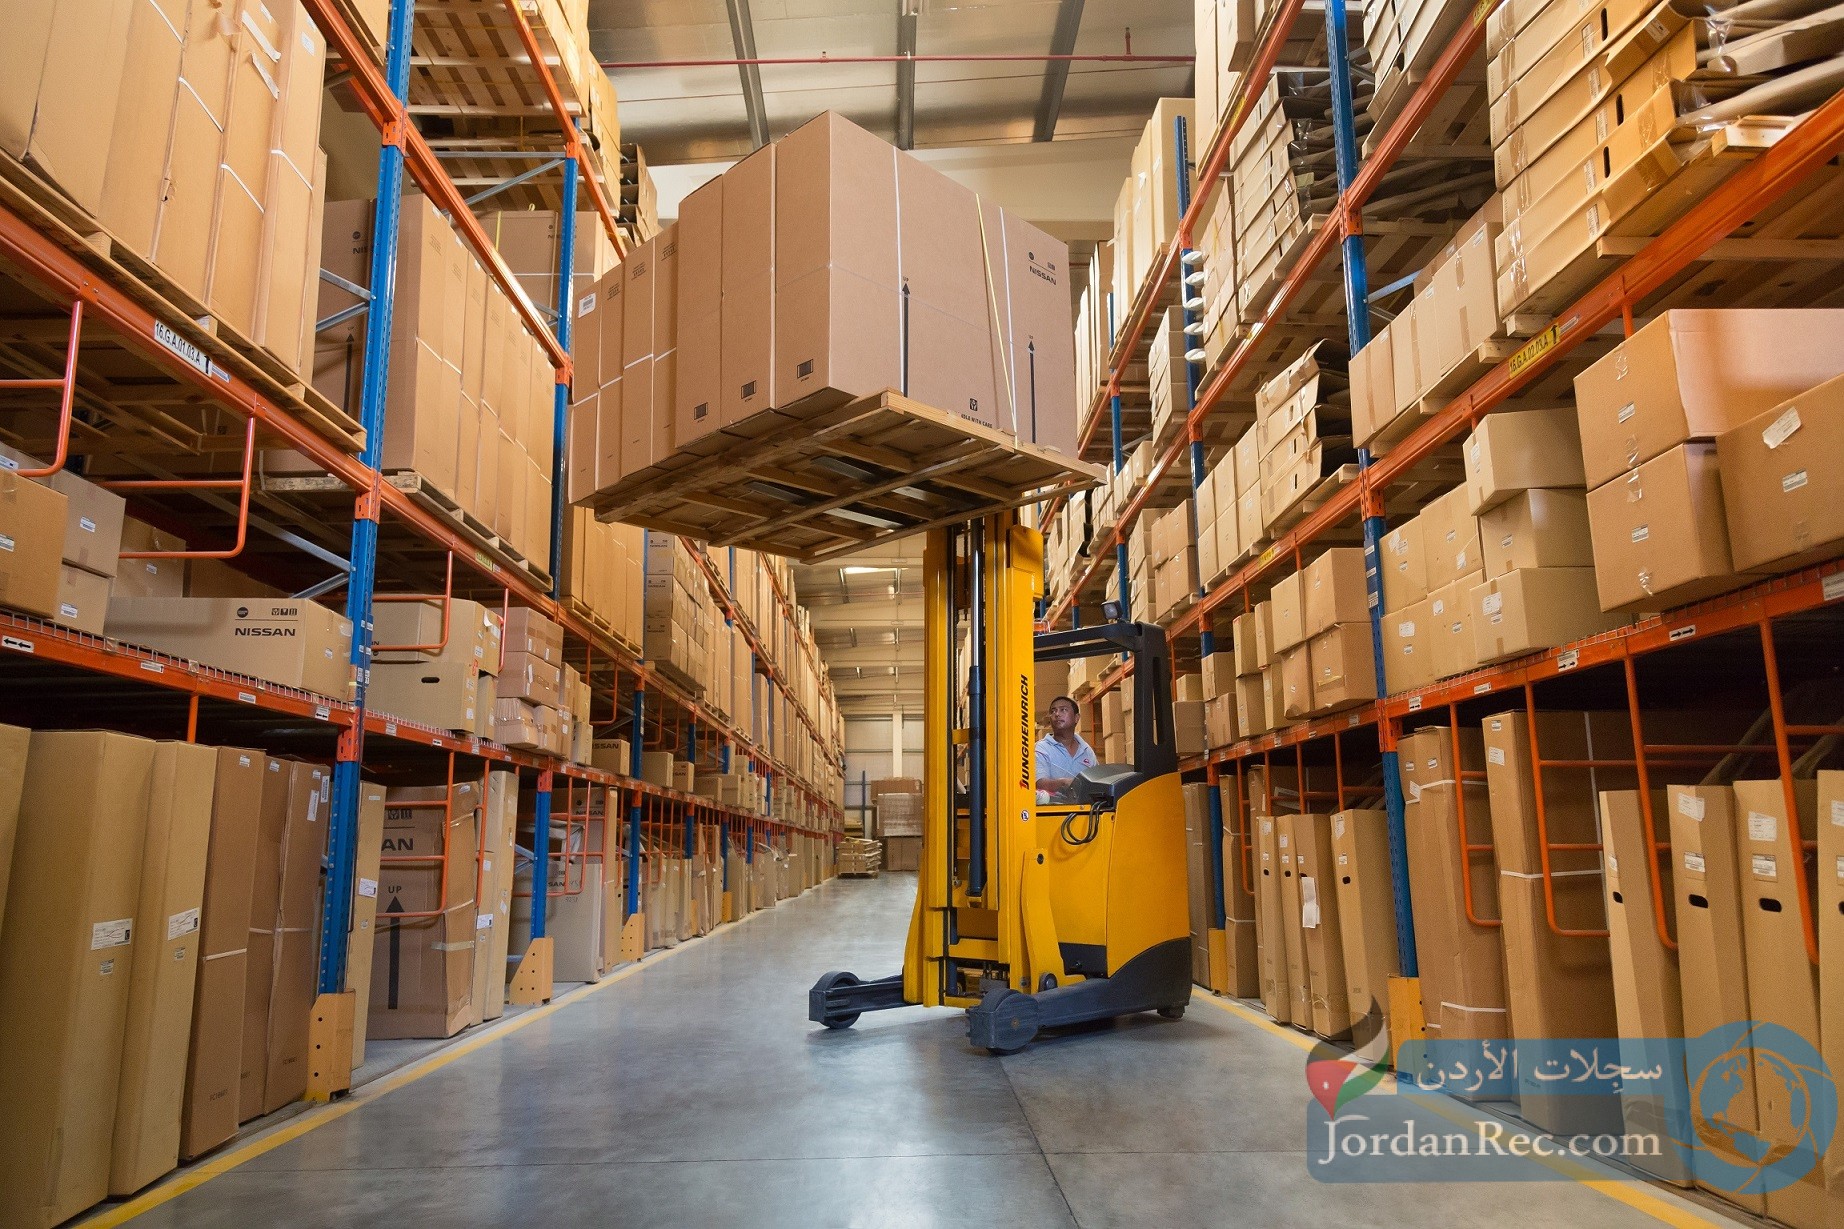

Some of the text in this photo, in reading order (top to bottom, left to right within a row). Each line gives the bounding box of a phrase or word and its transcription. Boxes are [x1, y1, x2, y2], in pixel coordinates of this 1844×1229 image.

[1029, 265, 1057, 286] NISSAN
[234, 627, 297, 637] NISSAN
[1019, 674, 1030, 790] JUNGHEINRICH
[388, 885, 402, 894] UP
